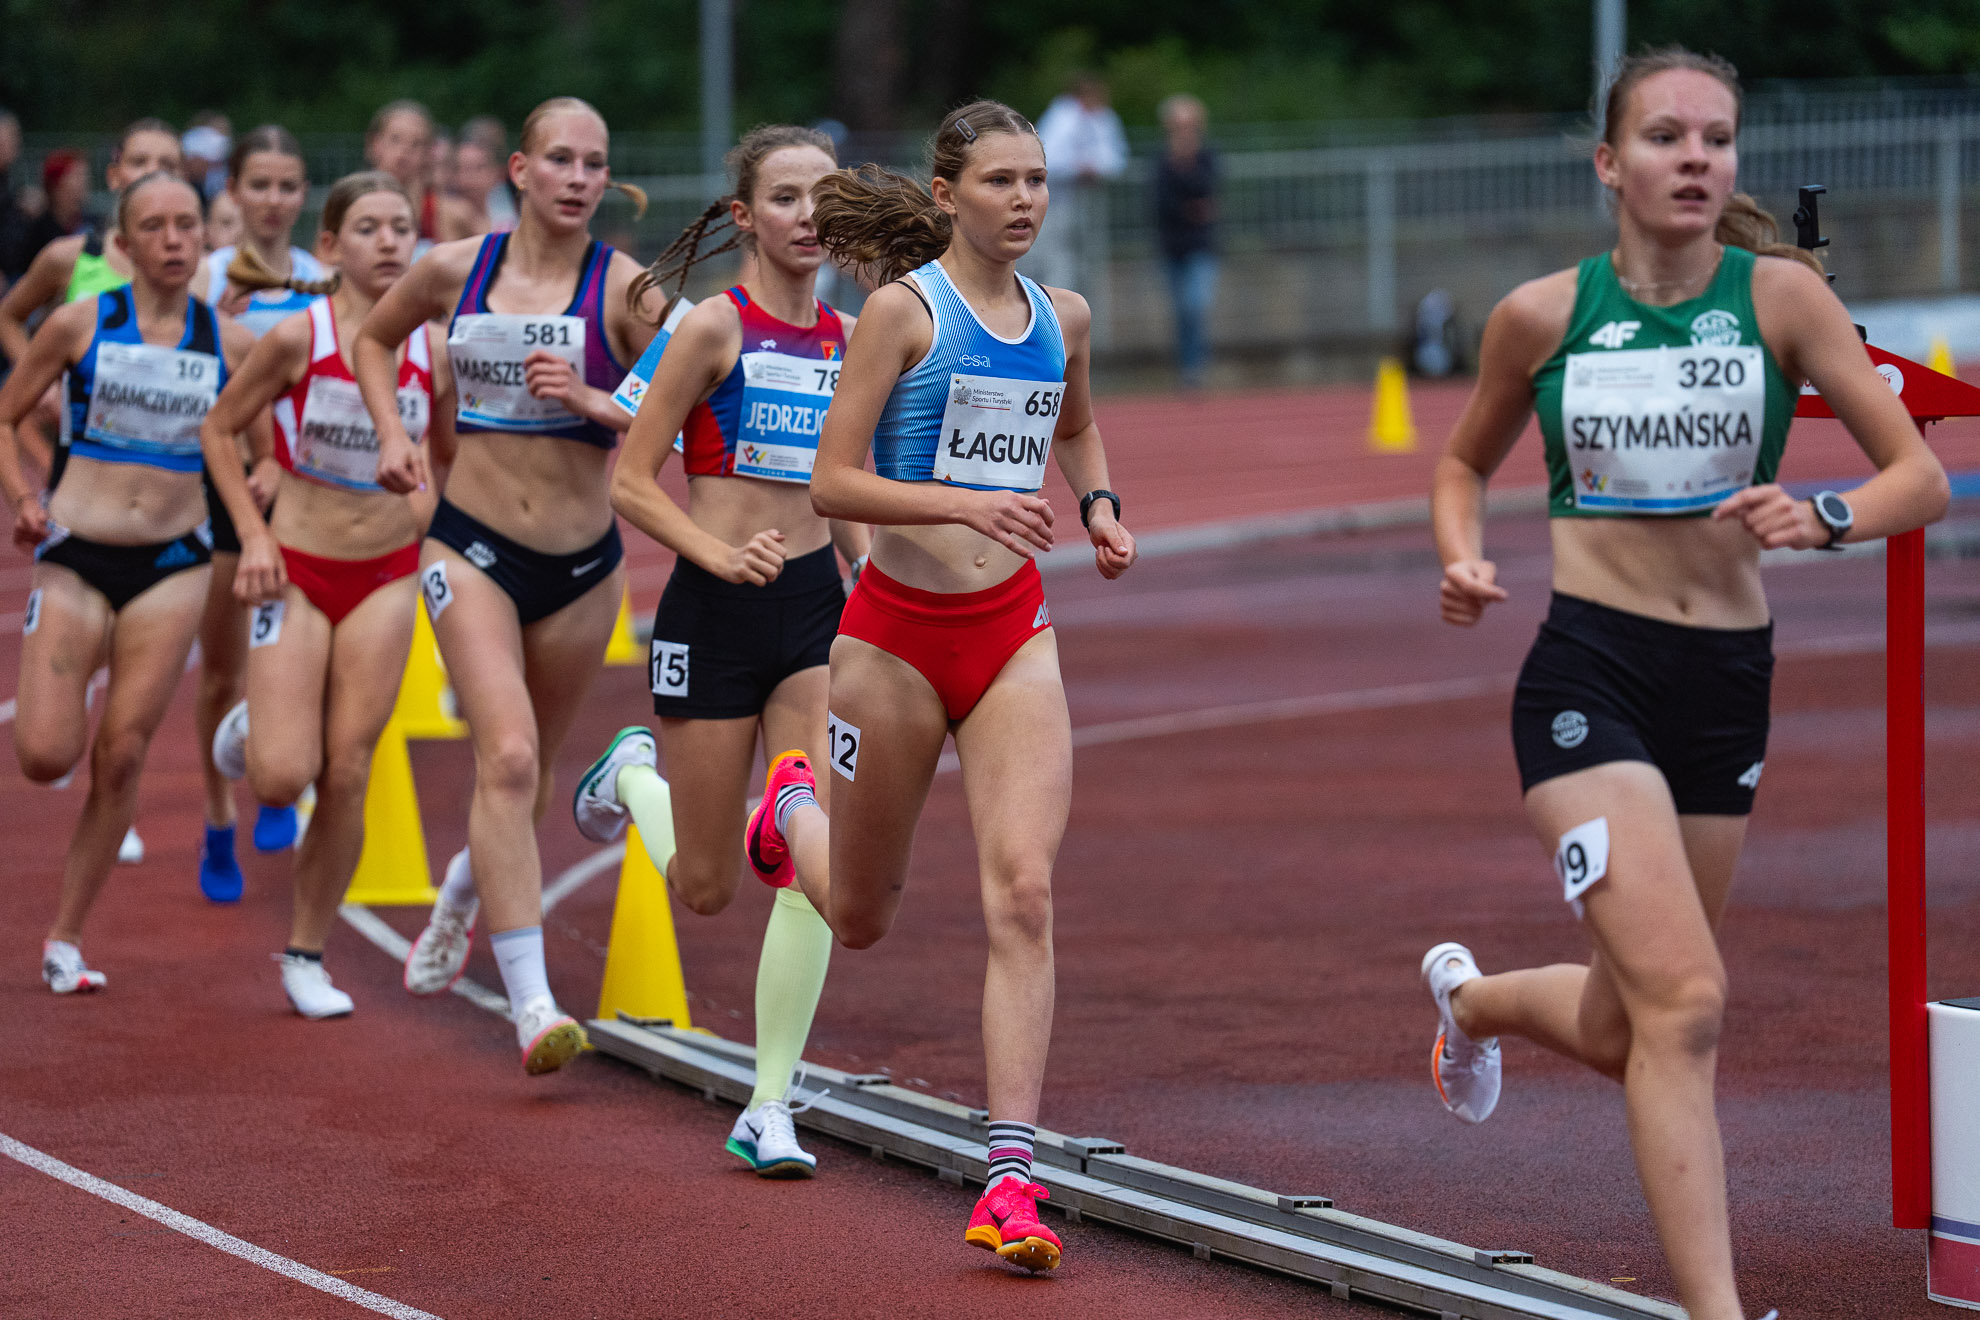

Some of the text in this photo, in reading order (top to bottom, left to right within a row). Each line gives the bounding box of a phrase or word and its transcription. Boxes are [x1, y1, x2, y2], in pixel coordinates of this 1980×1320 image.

[523, 323, 571, 345] 581
[1588, 320, 1642, 348] 4F
[177, 359, 204, 381] 10
[455, 358, 523, 386] MARSZE
[814, 368, 840, 392] 78
[1679, 358, 1745, 388] 320
[97, 382, 214, 417] ADAMCZEWSKA
[972, 388, 1004, 397] Ministerstwo
[992, 397, 1012, 405] Turystyki
[1025, 390, 1060, 417] 658
[304, 420, 380, 454] PRZEŹDZ
[1572, 405, 1752, 451] SZYMAŃSKA
[256, 605, 271, 640] 5
[654, 650, 686, 687] 15
[828, 724, 857, 772] 12
[1737, 761, 1764, 789] 4
[1567, 842, 1587, 884] 9
